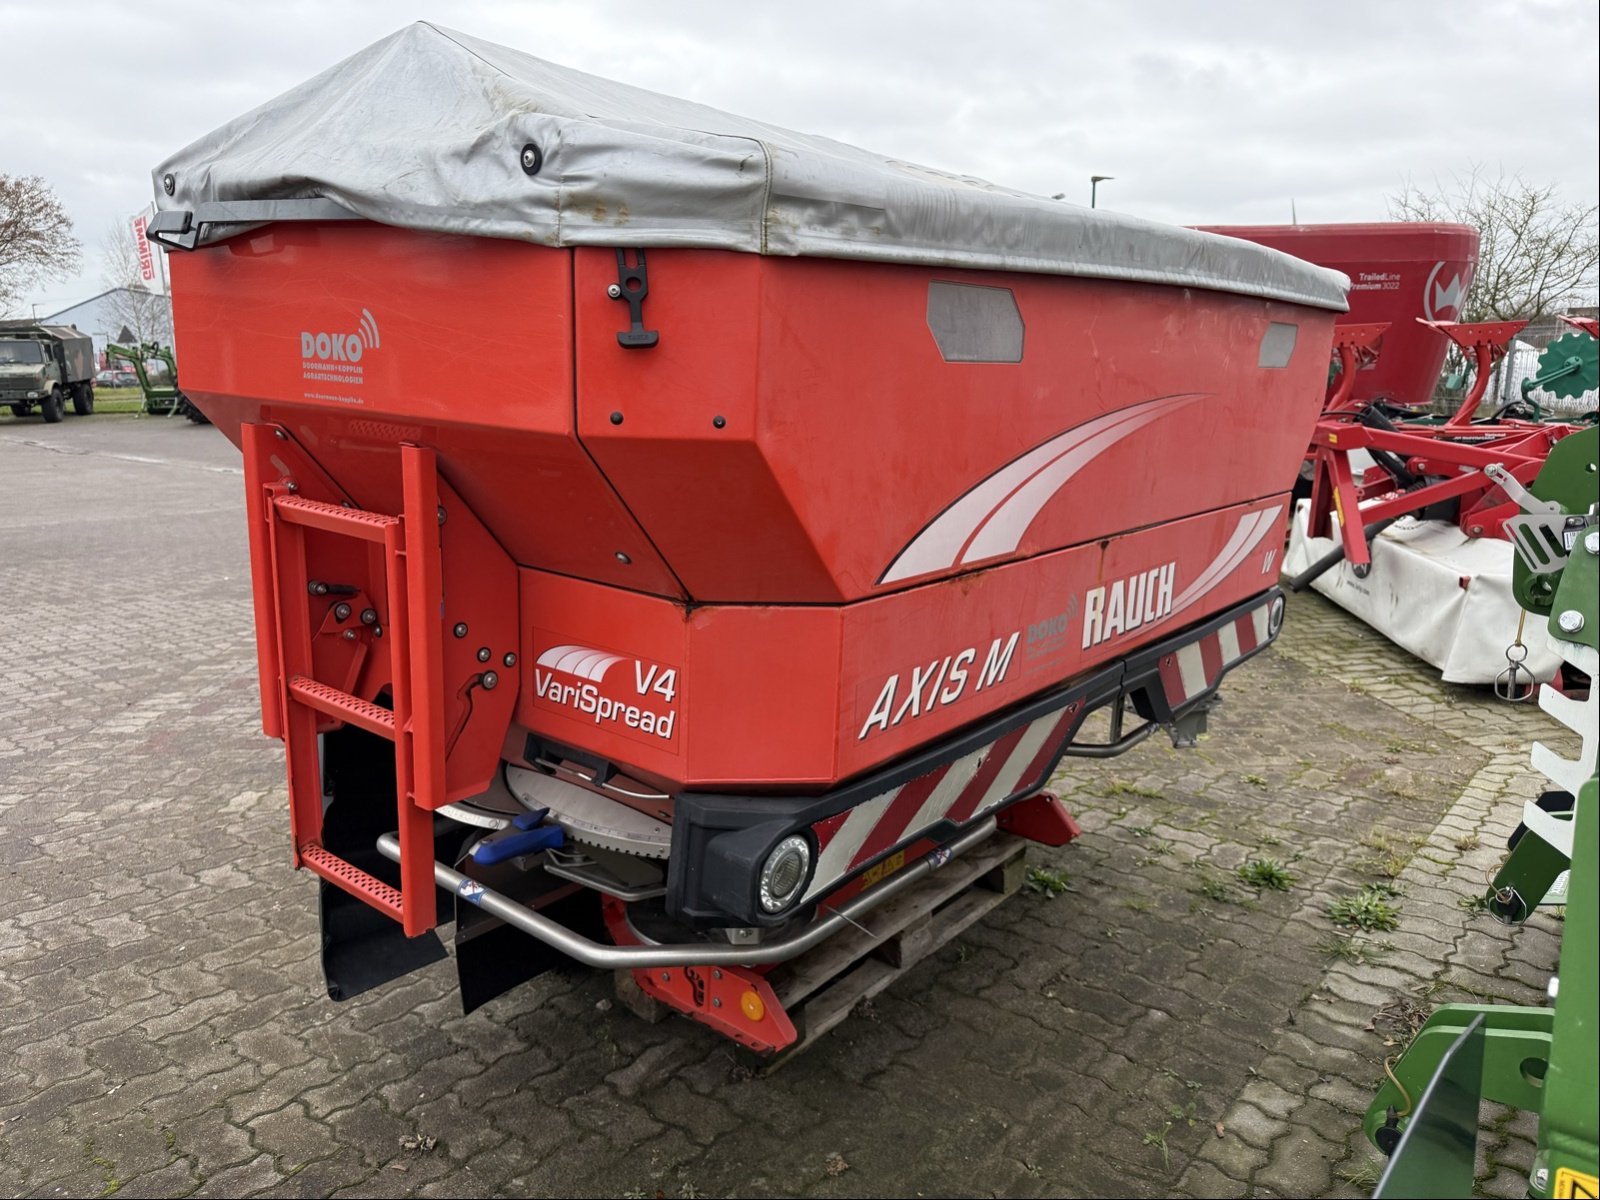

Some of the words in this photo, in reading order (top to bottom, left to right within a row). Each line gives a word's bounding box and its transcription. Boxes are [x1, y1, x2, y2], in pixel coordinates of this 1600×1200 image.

[1359, 272, 1401, 281] TrailedLine
[1382, 281, 1400, 290] 3022
[301, 331, 363, 362] DOKO
[1081, 562, 1177, 650] RAUCH
[1027, 613, 1069, 645] DOKO
[635, 659, 677, 703] V4
[857, 647, 976, 741] AXIS
[975, 631, 1020, 693] M
[535, 668, 676, 740] VariSpread
